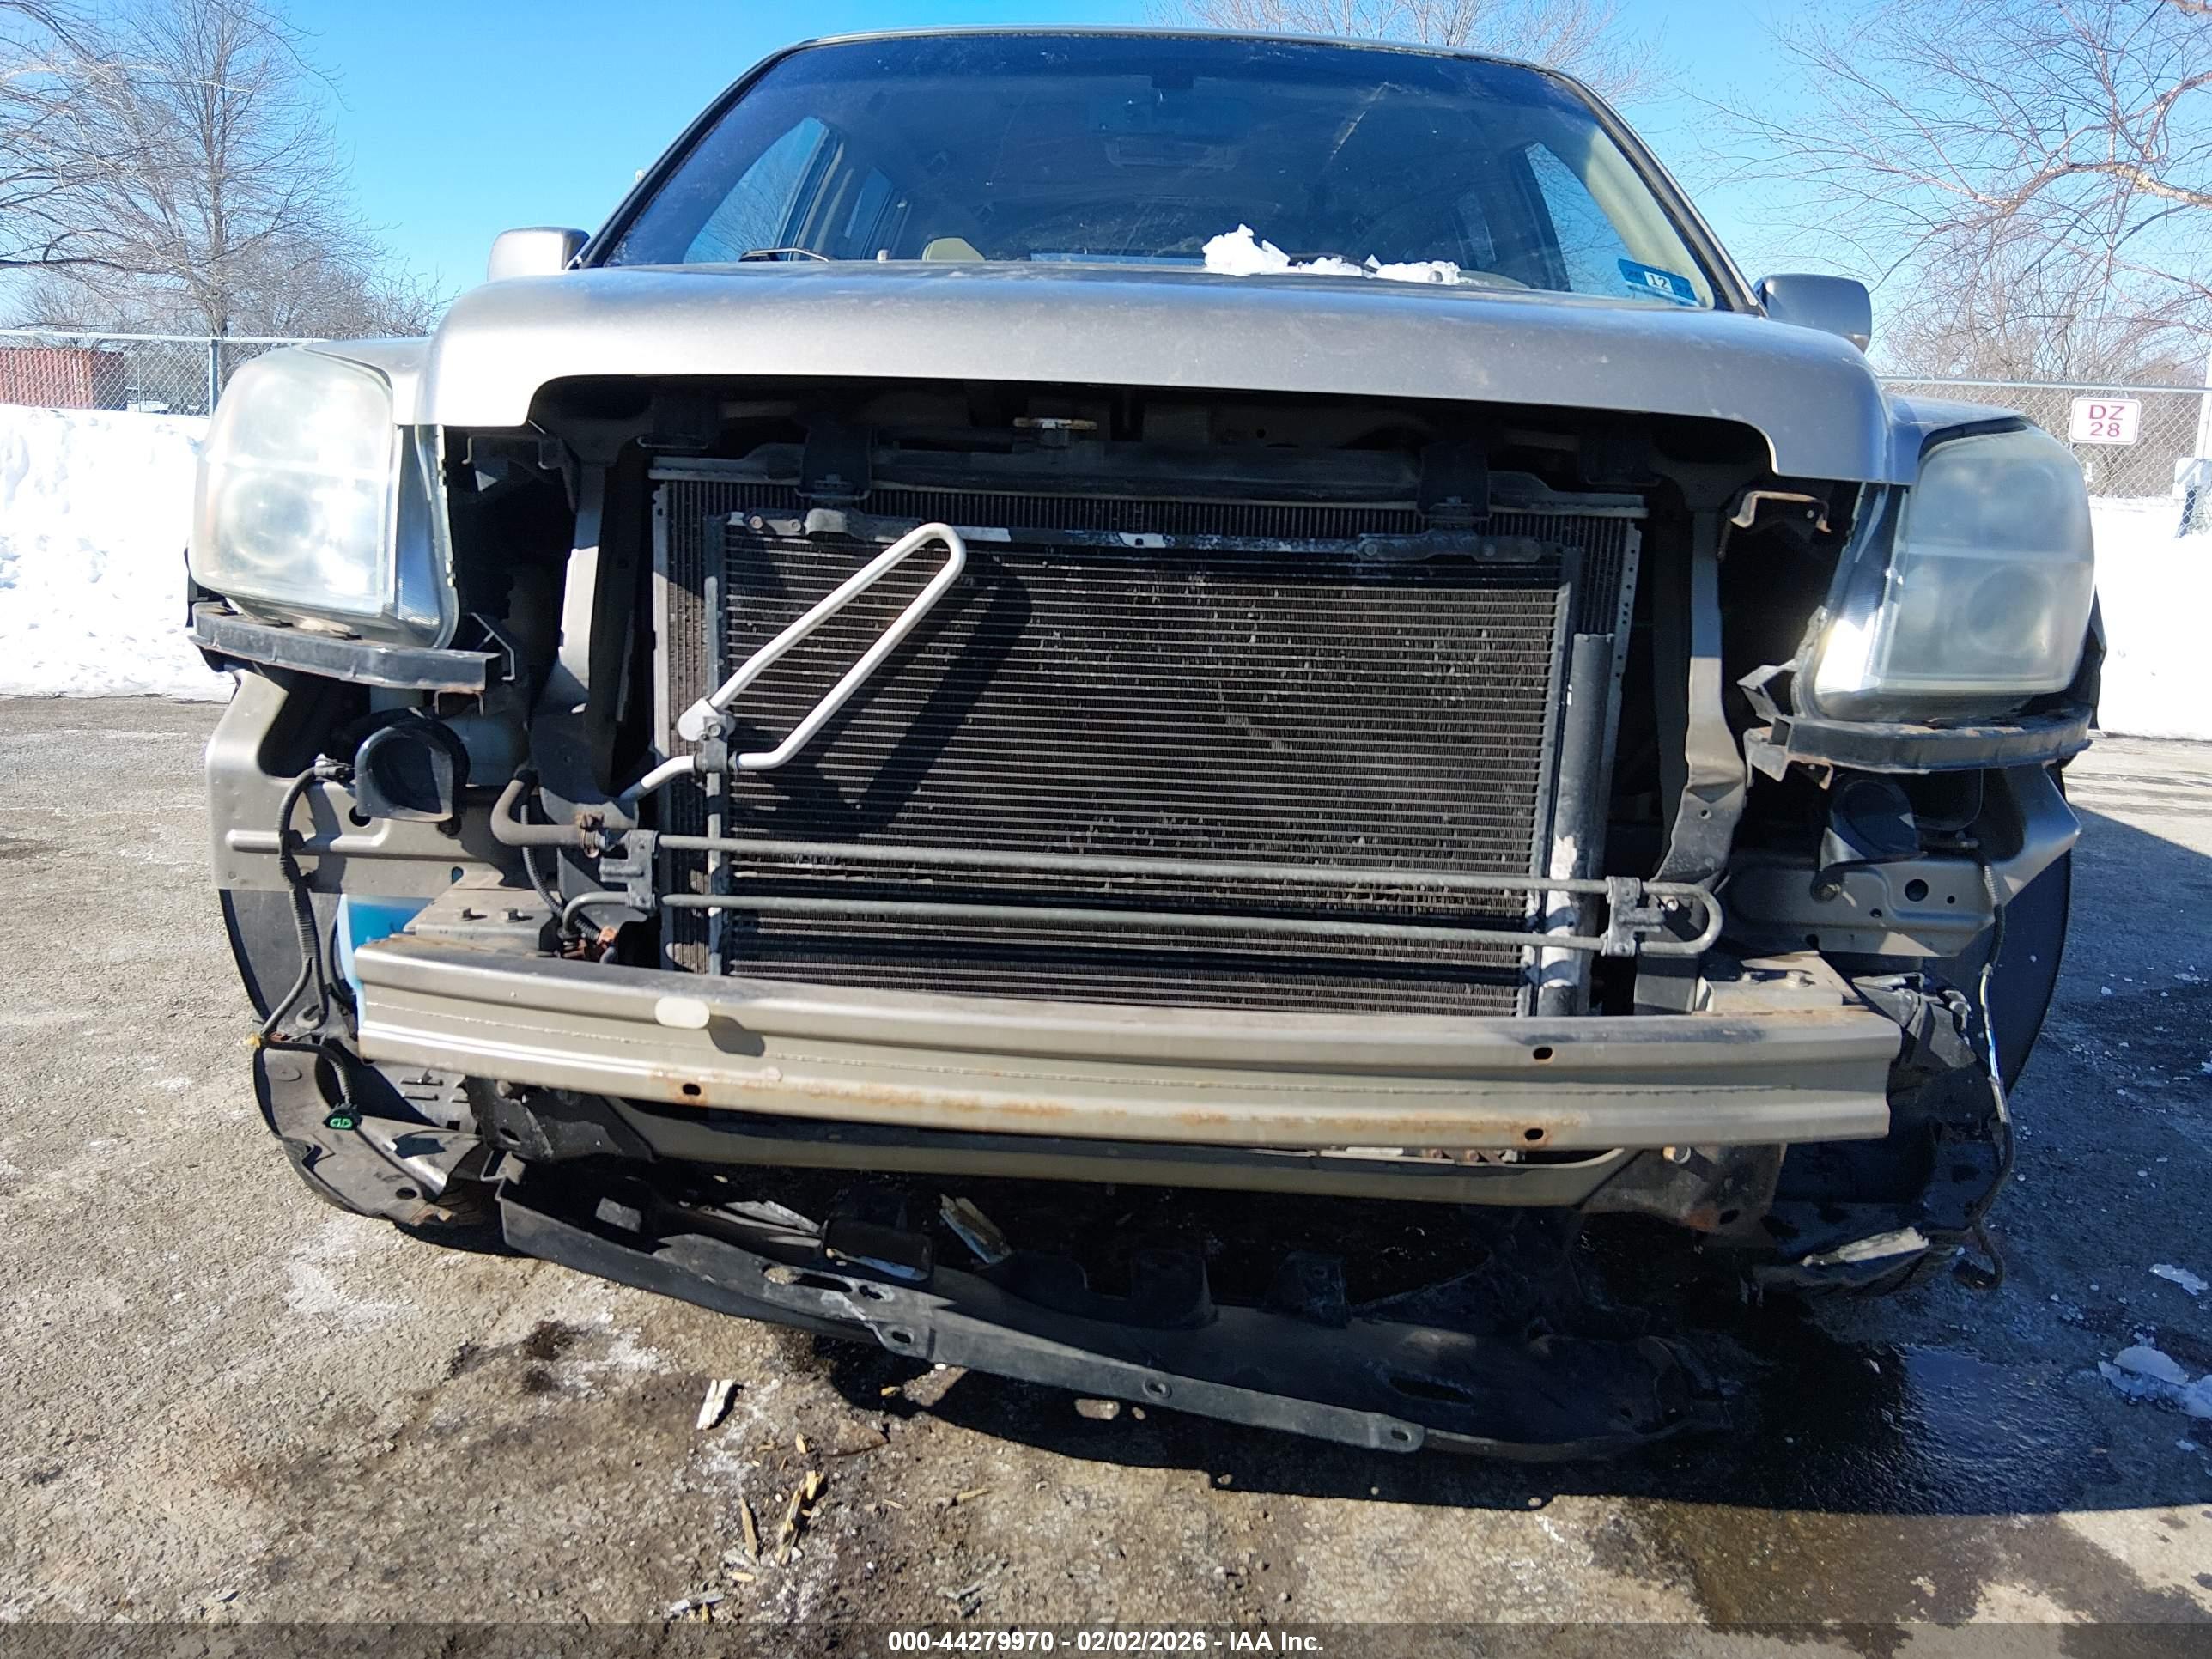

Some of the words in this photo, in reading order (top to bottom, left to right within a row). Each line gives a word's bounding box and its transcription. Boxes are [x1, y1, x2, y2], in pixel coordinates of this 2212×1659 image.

[1649, 274, 1668, 289] 12
[2088, 404, 2125, 421] DZ
[2089, 422, 2120, 437] 28
